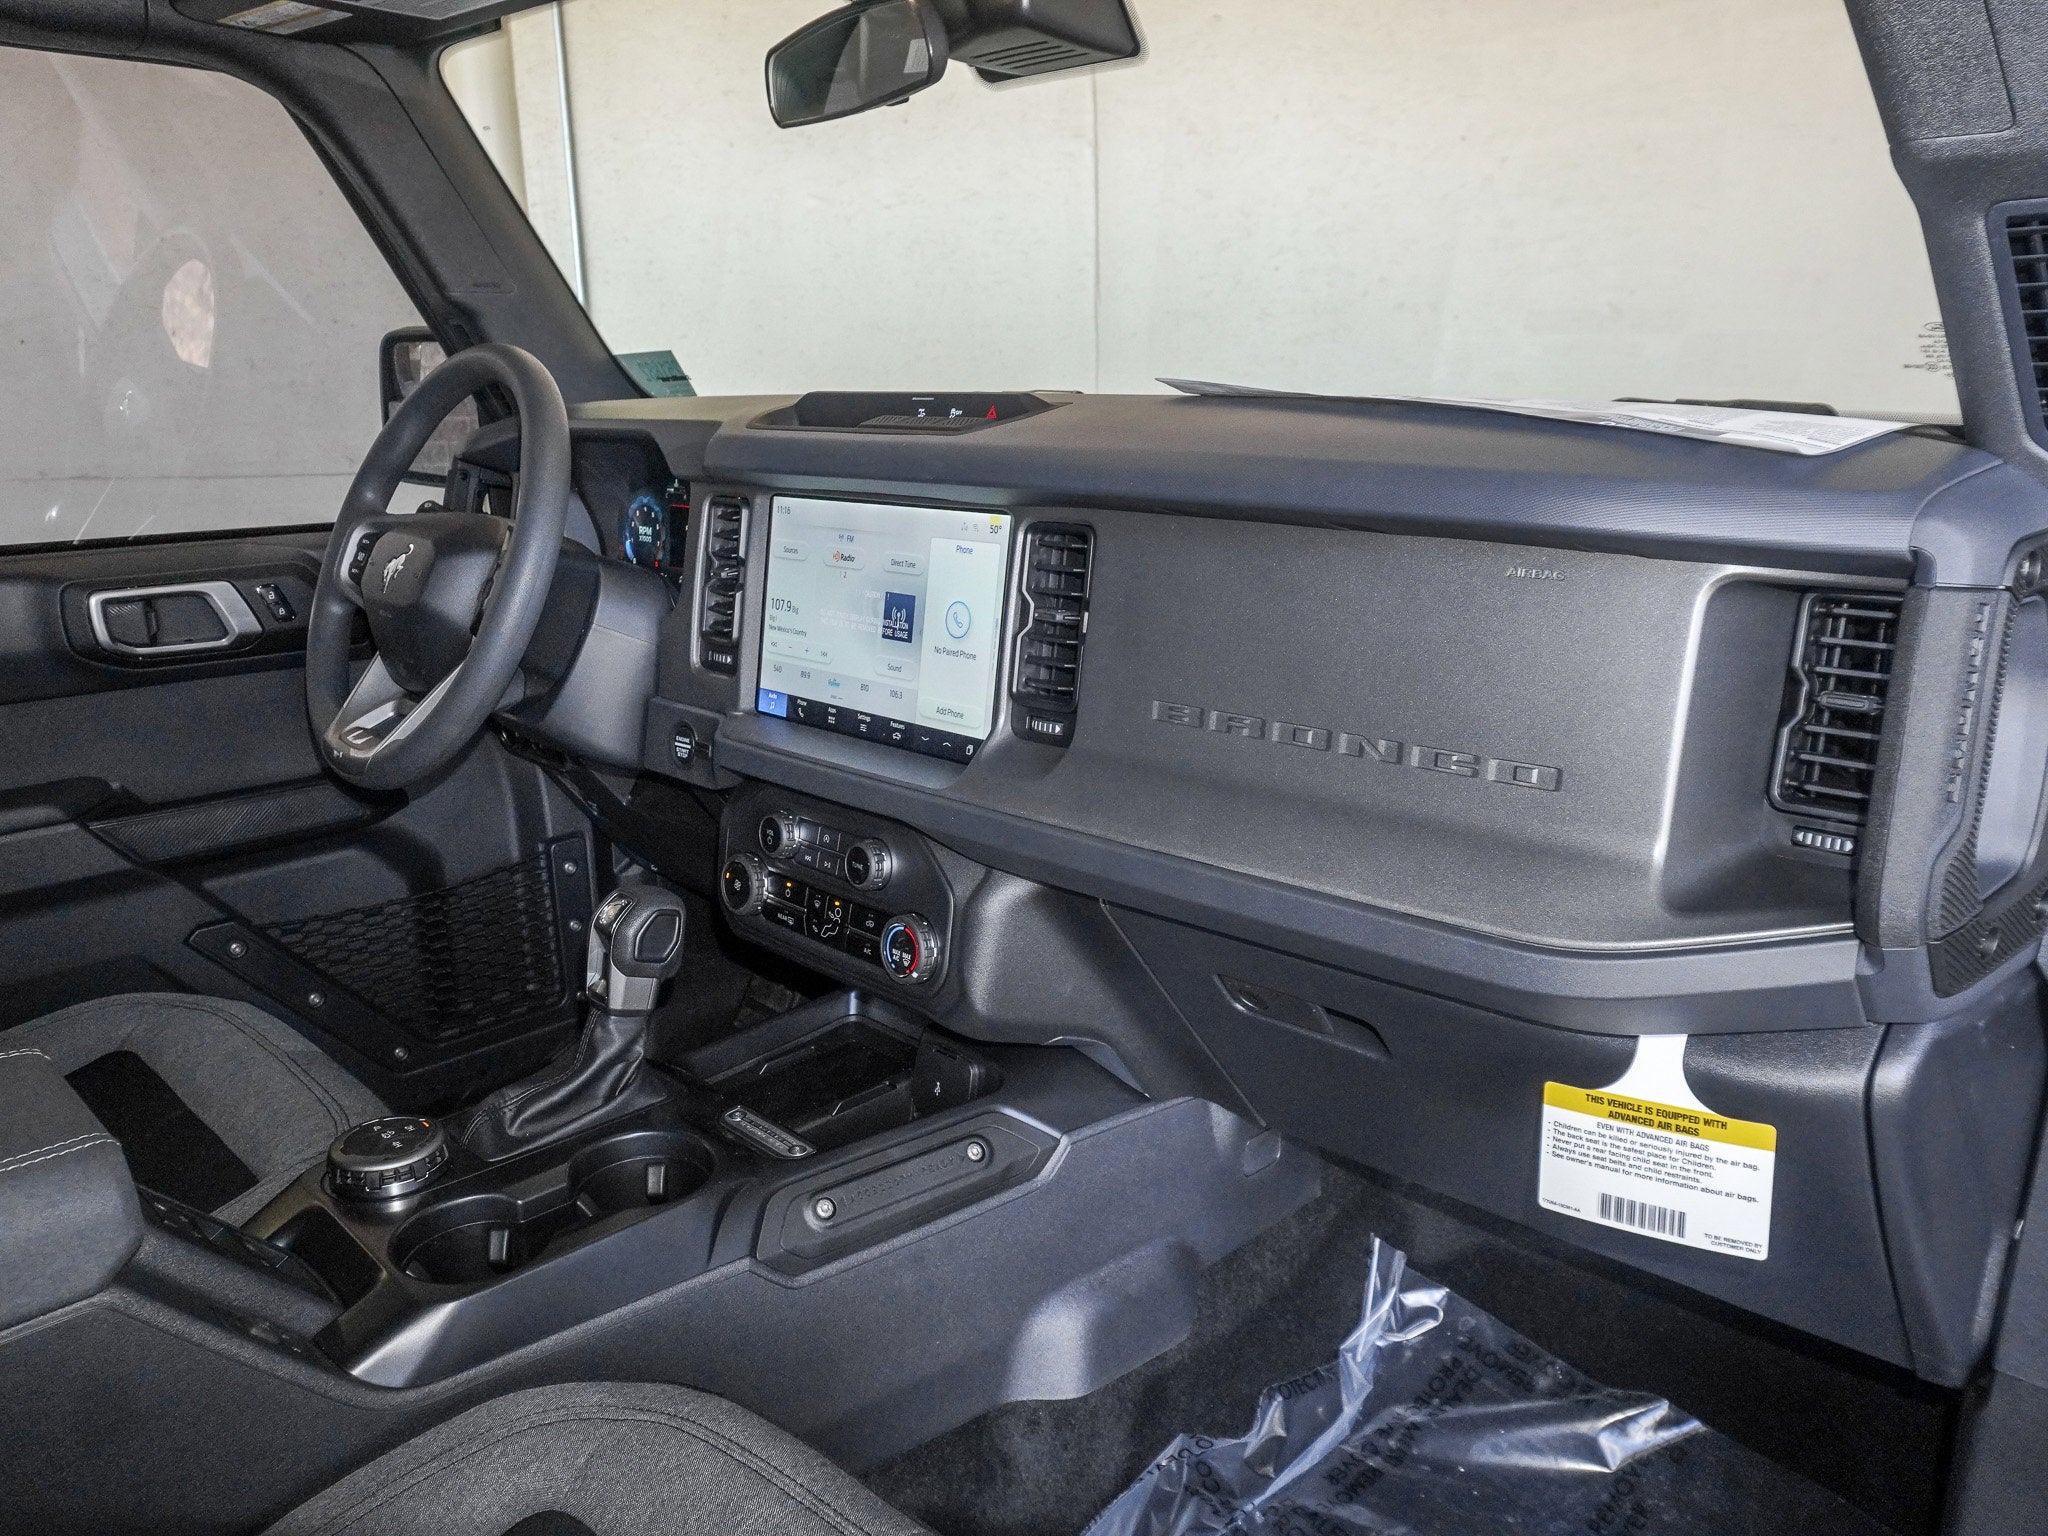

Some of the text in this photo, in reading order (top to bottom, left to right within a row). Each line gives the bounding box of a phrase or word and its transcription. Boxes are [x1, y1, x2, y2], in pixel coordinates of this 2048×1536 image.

[638, 526, 652, 536] RPM
[956, 545, 974, 555] Phone
[841, 553, 856, 562] Radio
[891, 558, 916, 569] Direct Tune
[1505, 565, 1566, 582] AIRBAG
[771, 598, 792, 612] 107.9
[792, 628, 807, 637] Country
[894, 630, 908, 639] USAGE
[934, 646, 977, 660] No Paired Phone
[887, 664, 902, 672] Sound
[858, 713, 871, 722] Settings
[936, 706, 964, 720] Add Phone
[1151, 699, 1563, 792] BRONCO
[1586, 1093, 1728, 1130] THIS VEHICLE IS EQUIPPED WITH
[1608, 1110, 1700, 1136] ADVANCED AIR BAGS
[1596, 1122, 1710, 1152] EVEN WITH ADVANCED AIR BAGS
[1553, 1120, 1582, 1133] Children
[1598, 1131, 1607, 1139] be
[1609, 1134, 1628, 1144] killed
[1640, 1140, 1673, 1154] seriously
[1675, 1149, 1702, 1160] injured
[1704, 1155, 1713, 1163] by
[1716, 1157, 1728, 1165] the
[1743, 1162, 1760, 1172] bag.
[1553, 1128, 1565, 1137] The
[1567, 1132, 1583, 1140] back
[1610, 1141, 1621, 1149] the
[1623, 1145, 1645, 1155] safest
[1647, 1149, 1667, 1160] place
[1681, 1158, 1716, 1171] Children.
[1552, 1136, 1572, 1146] Never
[1573, 1141, 1585, 1150] put
[1593, 1146, 1607, 1154] rear
[1608, 1149, 1630, 1160] facing
[1632, 1155, 1651, 1164] child
[1652, 1160, 1668, 1168] seat
[1693, 1168, 1714, 1179] front.
[1552, 1143, 1577, 1155] Always
[1592, 1154, 1607, 1162] seat
[1609, 1158, 1626, 1167] belts
[1628, 1162, 1642, 1170] and
[1644, 1166, 1661, 1175] child
[1664, 1171, 1702, 1184] restraints.
[1552, 1151, 1564, 1159] See
[1566, 1156, 1592, 1167] owner's
[1594, 1162, 1621, 1174] manual
[1622, 1168, 1632, 1176] for
[1634, 1172, 1653, 1182] more
[1655, 1177, 1699, 1191] information
[1700, 1187, 1723, 1196] about
[1737, 1193, 1760, 1203] bags.
[1711, 1240, 1744, 1250] CUSTOMER
[1724, 1237, 1753, 1247] REMOVED
